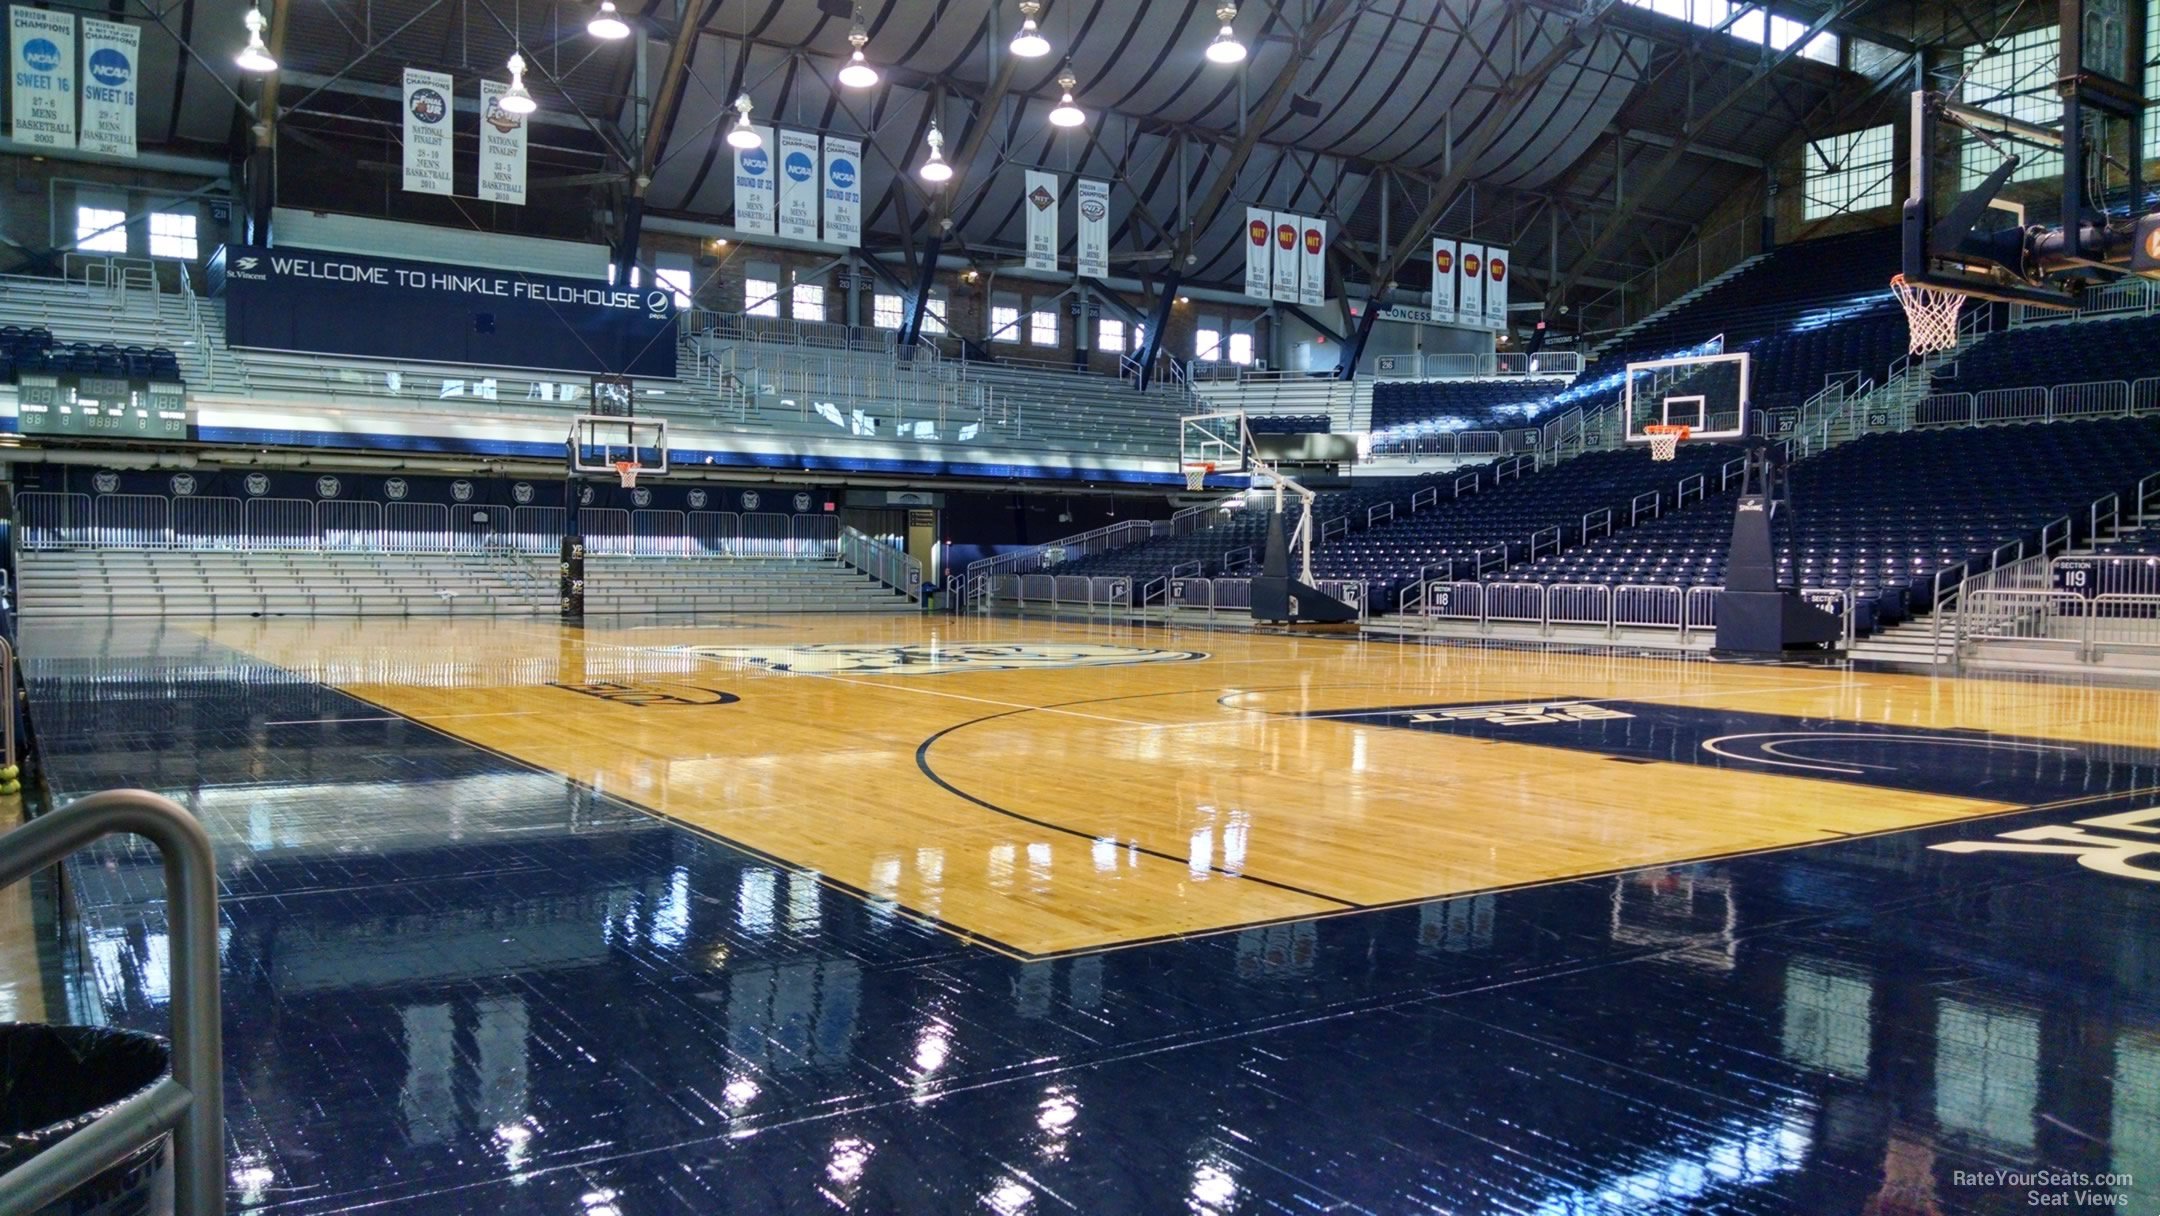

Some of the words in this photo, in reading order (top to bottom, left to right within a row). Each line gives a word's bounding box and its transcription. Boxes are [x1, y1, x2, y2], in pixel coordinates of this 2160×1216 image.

[15, 19, 71, 35] CHAMPIONS
[85, 31, 137, 47] CHAMPIONS
[27, 52, 59, 64] NCAA
[93, 63, 130, 79] NCAA
[16, 73, 51, 90] SWEET
[57, 77, 70, 92] 16
[406, 78, 450, 91] CHAMPIONS
[86, 86, 121, 103] SWEET
[124, 91, 134, 105] 16
[16, 119, 72, 134] BASKETBALL
[412, 126, 443, 138] NATIONAL
[34, 134, 54, 144] 2003
[84, 130, 133, 145] BASKETBALL
[414, 136, 442, 147] FINALIST
[487, 136, 519, 148] NATIONAL
[489, 146, 518, 157] FINALIST
[782, 140, 816, 151] CHAMPIONS
[826, 147, 859, 158] CHAMPIONS
[743, 158, 768, 169] NCAA
[406, 167, 450, 181] BASKETBALL
[788, 165, 812, 176] NCAA
[832, 171, 855, 182] NCAA
[482, 180, 523, 193] BASKETBALL
[826, 188, 844, 201] ROUND
[845, 191, 852, 201] OF
[852, 193, 859, 203] 32
[1080, 190, 1107, 200] CHAMPIONS
[737, 209, 773, 221] BASKETBALL
[781, 216, 816, 228] BASKETBALL
[826, 221, 858, 233] BASKETBALL
[1252, 227, 1265, 238] NIT
[1280, 231, 1293, 242] NIT
[1307, 236, 1320, 247] NIT
[1438, 256, 1450, 266] NIT
[1465, 260, 1477, 270] NIT
[1492, 265, 1503, 274] NIT
[271, 257, 388, 285] WELCOME
[395, 269, 425, 289] TO
[432, 273, 508, 297] HINKLE
[514, 282, 641, 310] FIELDHOUSE
[1780, 421, 1793, 431] 217
[1871, 415, 1886, 425] 218
[2065, 570, 2086, 587] 119
[1436, 593, 1449, 605] 118
